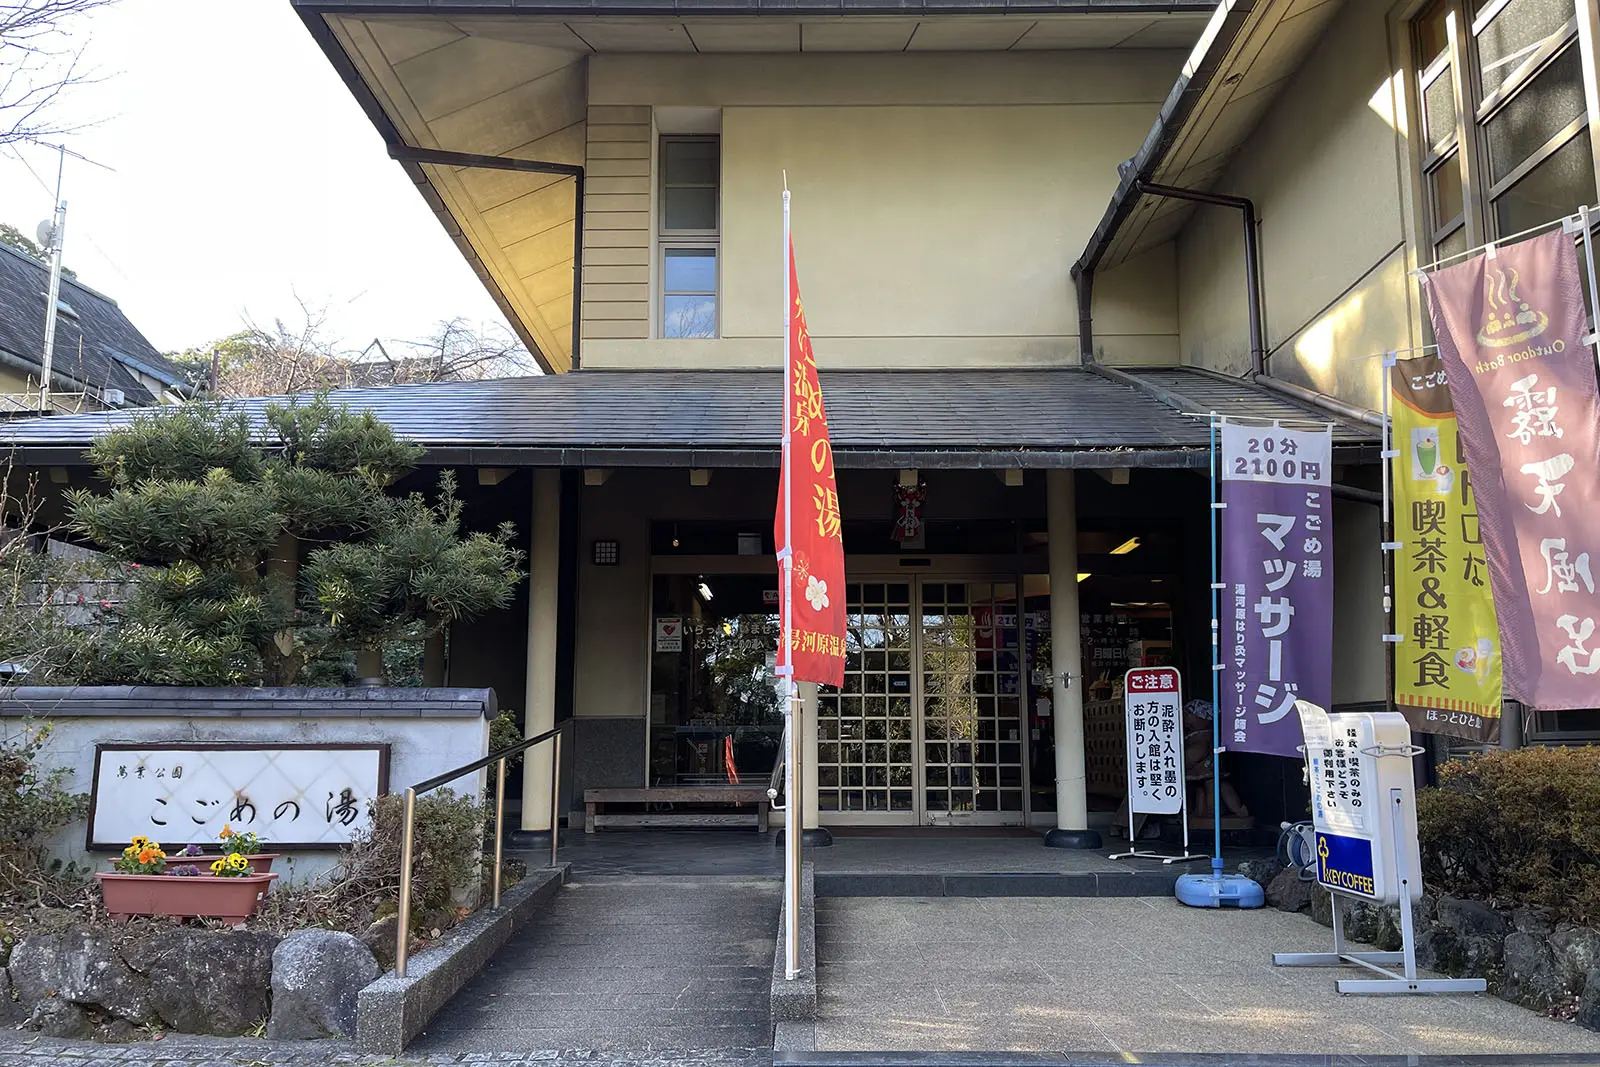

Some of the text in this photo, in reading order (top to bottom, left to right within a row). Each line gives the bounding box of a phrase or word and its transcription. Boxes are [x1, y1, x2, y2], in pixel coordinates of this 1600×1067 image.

[1234, 456, 1322, 481] 2100円
[1247, 436, 1299, 457] 20分
[1302, 490, 1323, 579] こごめ湯
[1254, 512, 1299, 725] マッサージ
[1411, 499, 1450, 690] 喫茶&軽食
[1131, 673, 1174, 690] ご注意
[1133, 703, 1149, 797] お断りします。
[1147, 700, 1162, 801] 方の入館は堅く
[1161, 704, 1177, 798] 泥酔・入れ墨の
[1323, 748, 1337, 808] 御利用下さい
[1335, 738, 1349, 801] お客様どうぞ
[150, 787, 358, 827] こごめの湯
[1325, 867, 1374, 894] KEY COFFEE
